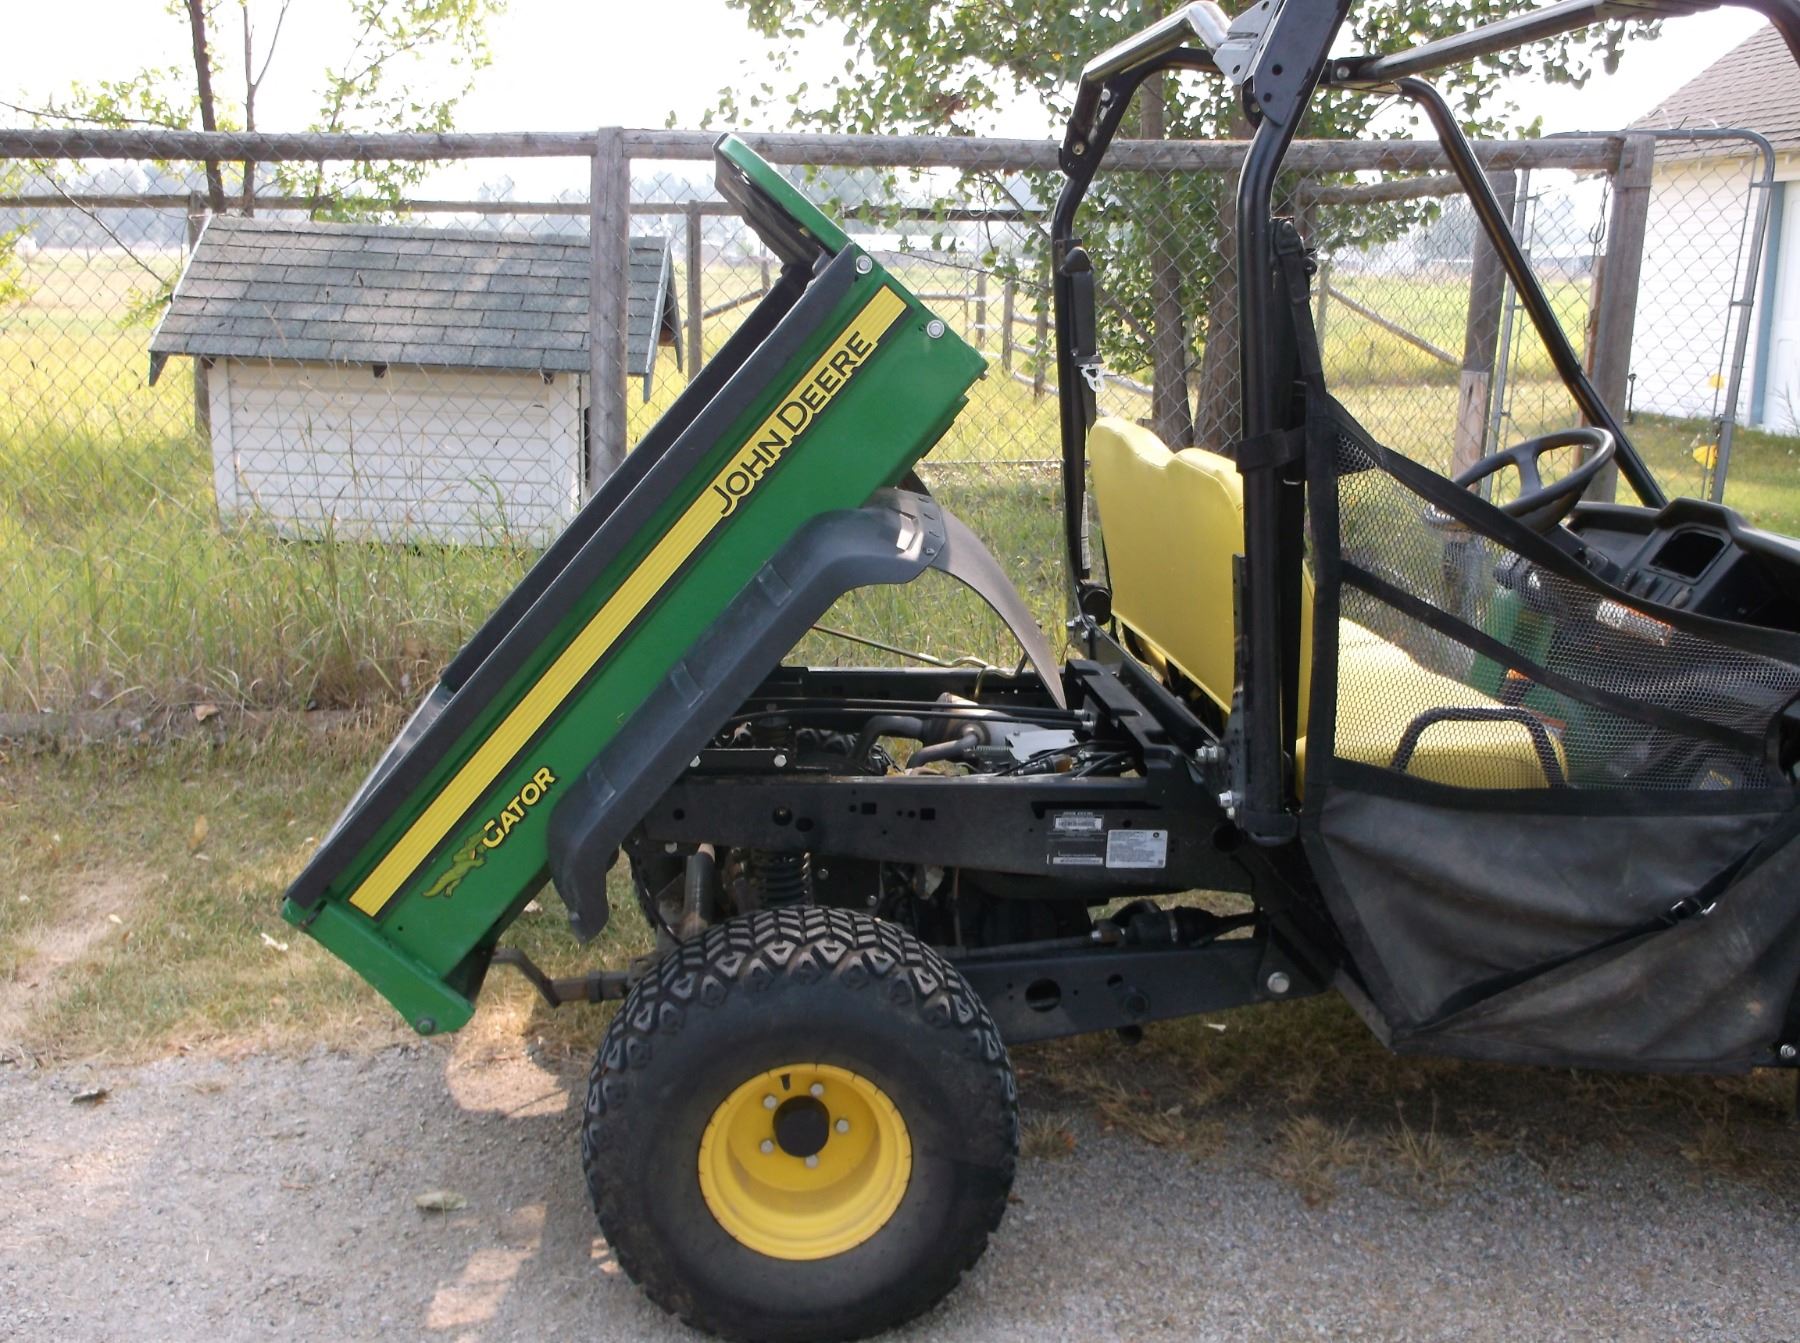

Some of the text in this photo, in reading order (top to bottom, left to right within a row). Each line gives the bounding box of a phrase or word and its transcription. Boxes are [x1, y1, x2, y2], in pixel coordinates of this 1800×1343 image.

[713, 330, 873, 516] JOHN DEERE
[481, 766, 556, 849] GATOR
